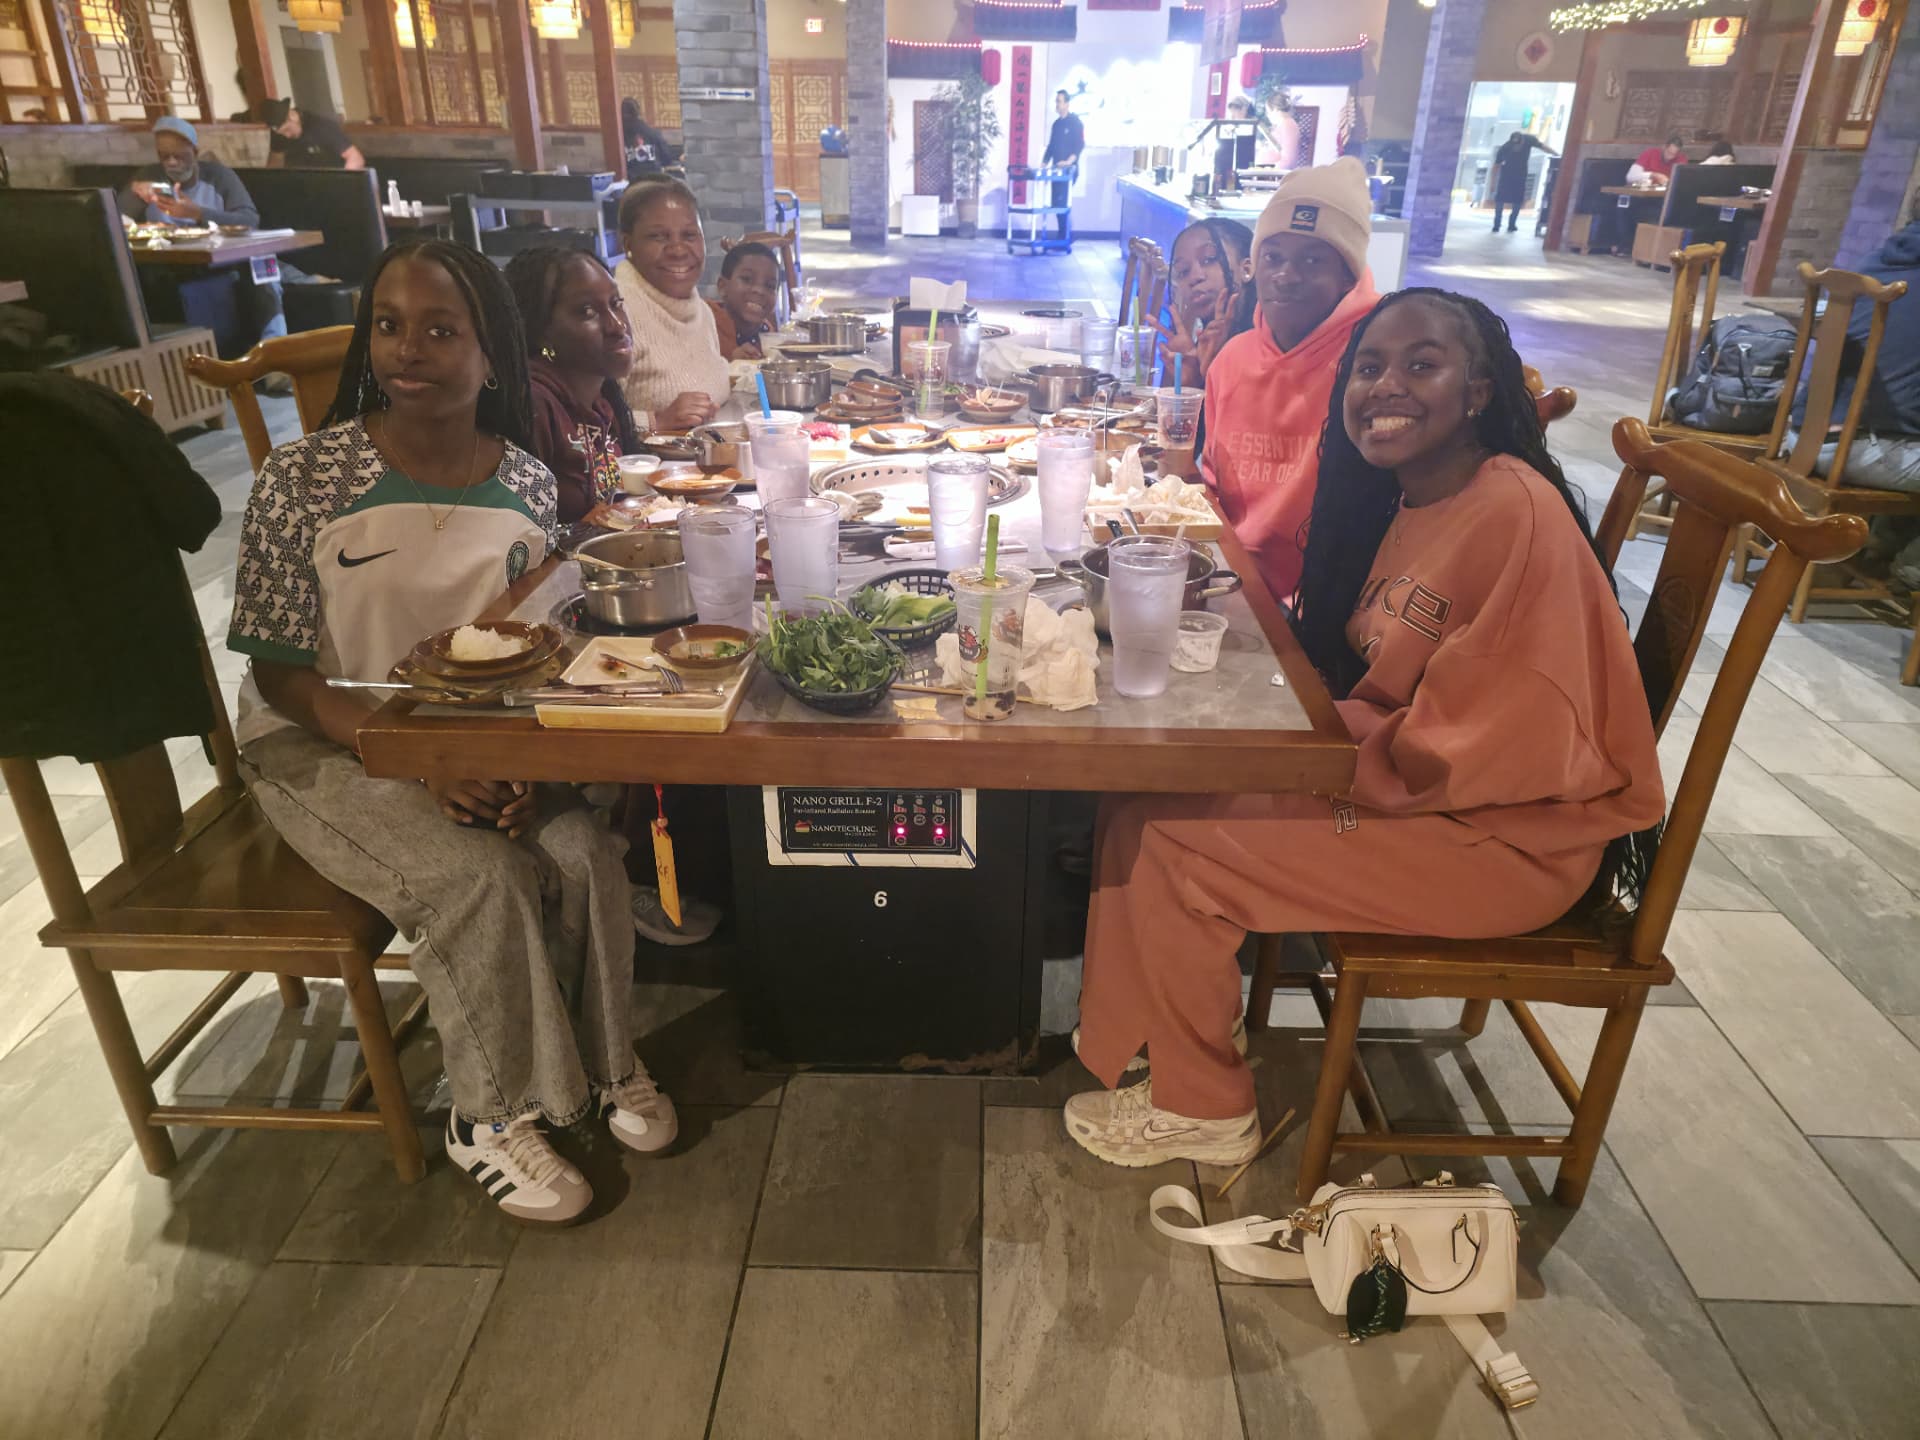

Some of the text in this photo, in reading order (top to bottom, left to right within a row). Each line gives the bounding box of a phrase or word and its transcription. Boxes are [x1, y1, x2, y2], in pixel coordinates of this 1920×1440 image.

[793, 796, 883, 806] NANO GRILL F-2
[873, 890, 888, 908] 6
